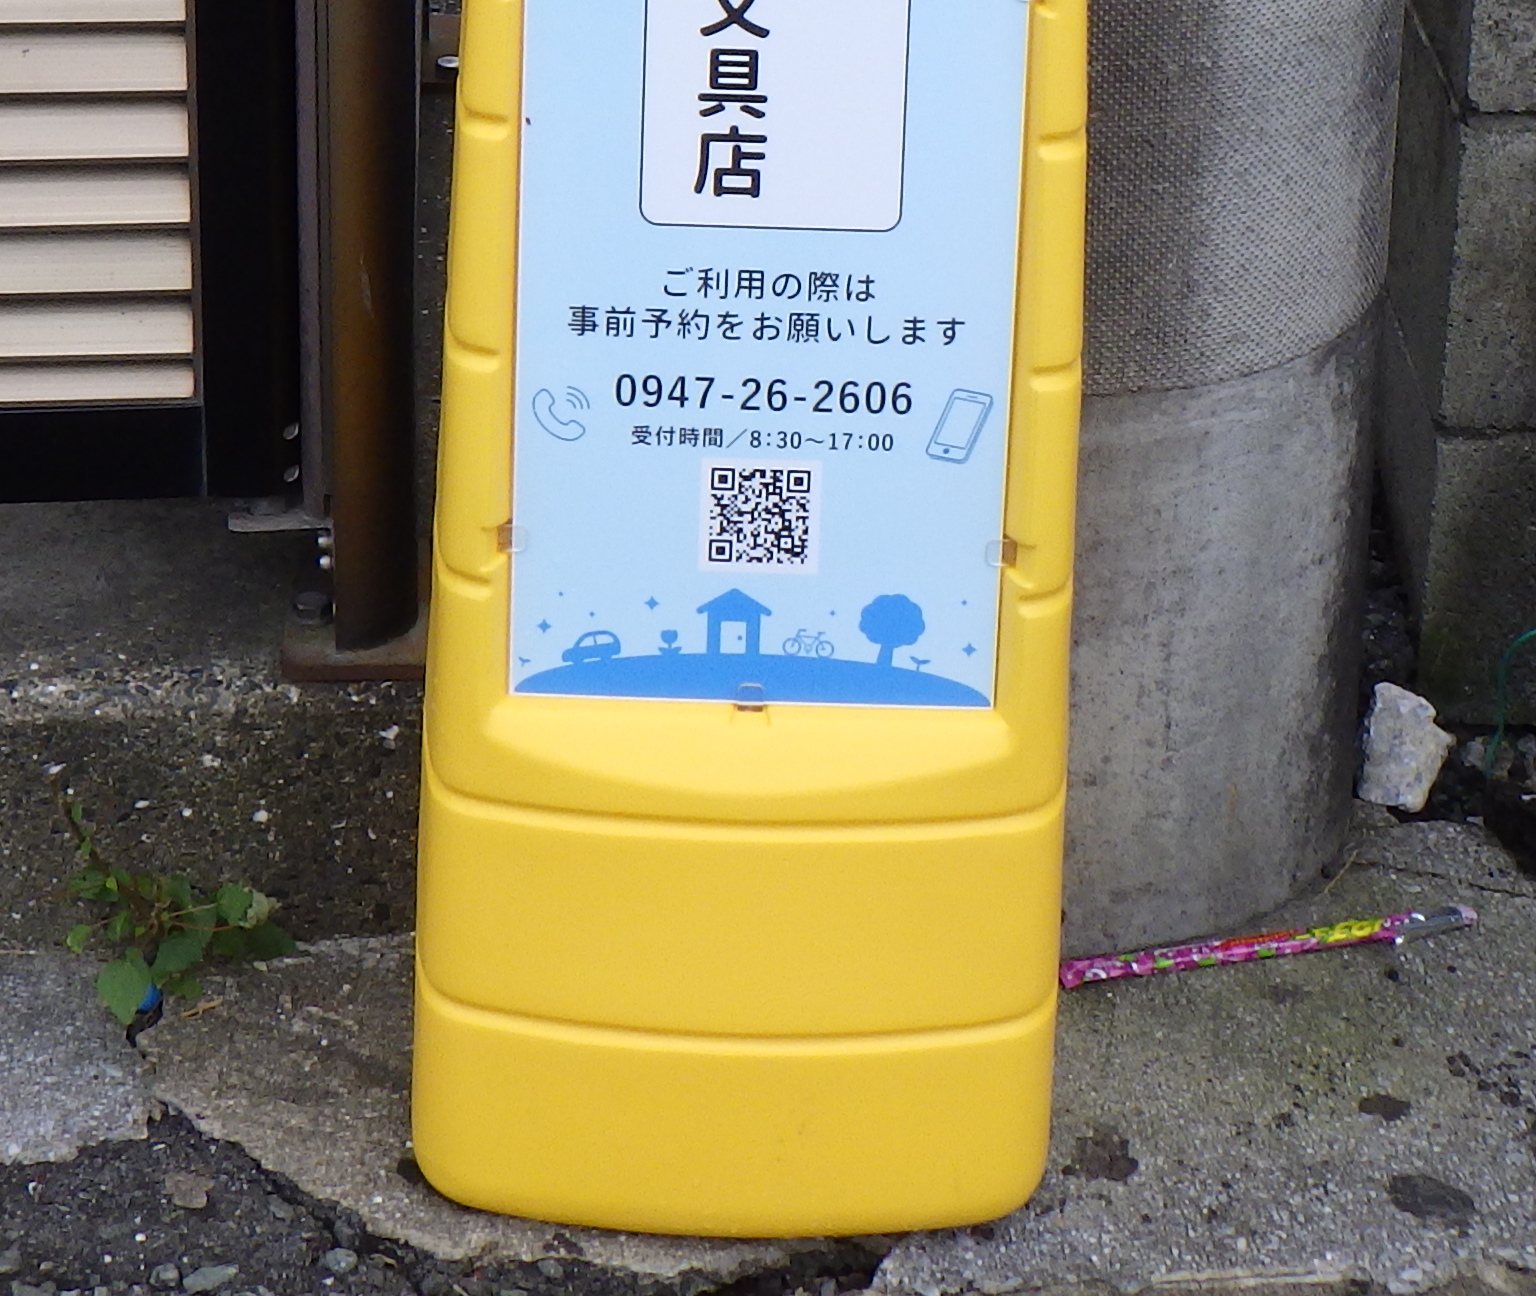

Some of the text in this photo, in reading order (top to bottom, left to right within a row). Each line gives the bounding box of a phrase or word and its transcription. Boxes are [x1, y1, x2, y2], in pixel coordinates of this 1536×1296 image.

[662, 266, 877, 303] ご利用の際は
[567, 304, 966, 347] 事前予約をお願いします
[614, 373, 914, 416] 0947-26-2606
